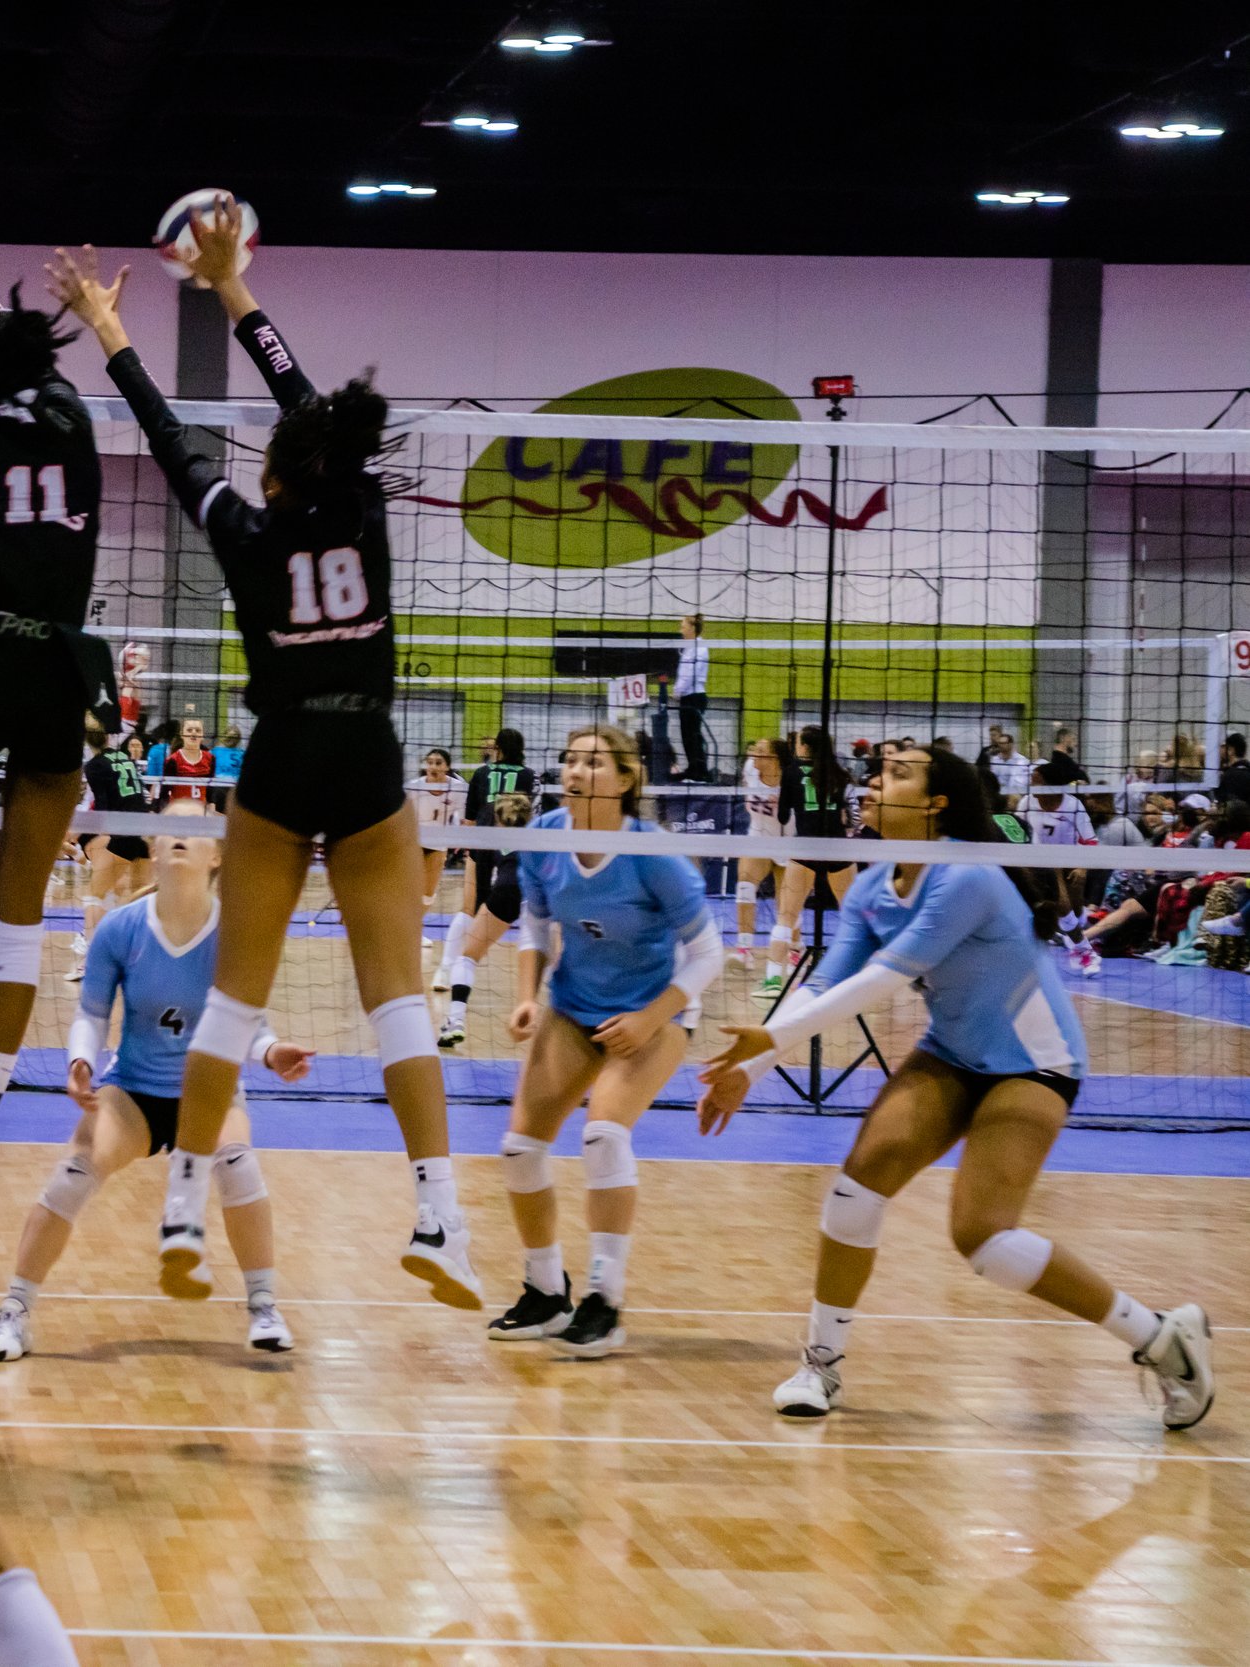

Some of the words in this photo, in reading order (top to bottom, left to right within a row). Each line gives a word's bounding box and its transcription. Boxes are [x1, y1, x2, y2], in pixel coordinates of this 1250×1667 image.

[254, 325, 293, 374] METRO
[505, 436, 751, 484] CAFE
[5, 465, 67, 524] 11
[288, 547, 369, 623] 18
[1235, 640, 1250, 670] 9
[621, 681, 643, 700] 10
[1043, 824, 1054, 836] 7
[158, 1006, 185, 1039] 4
